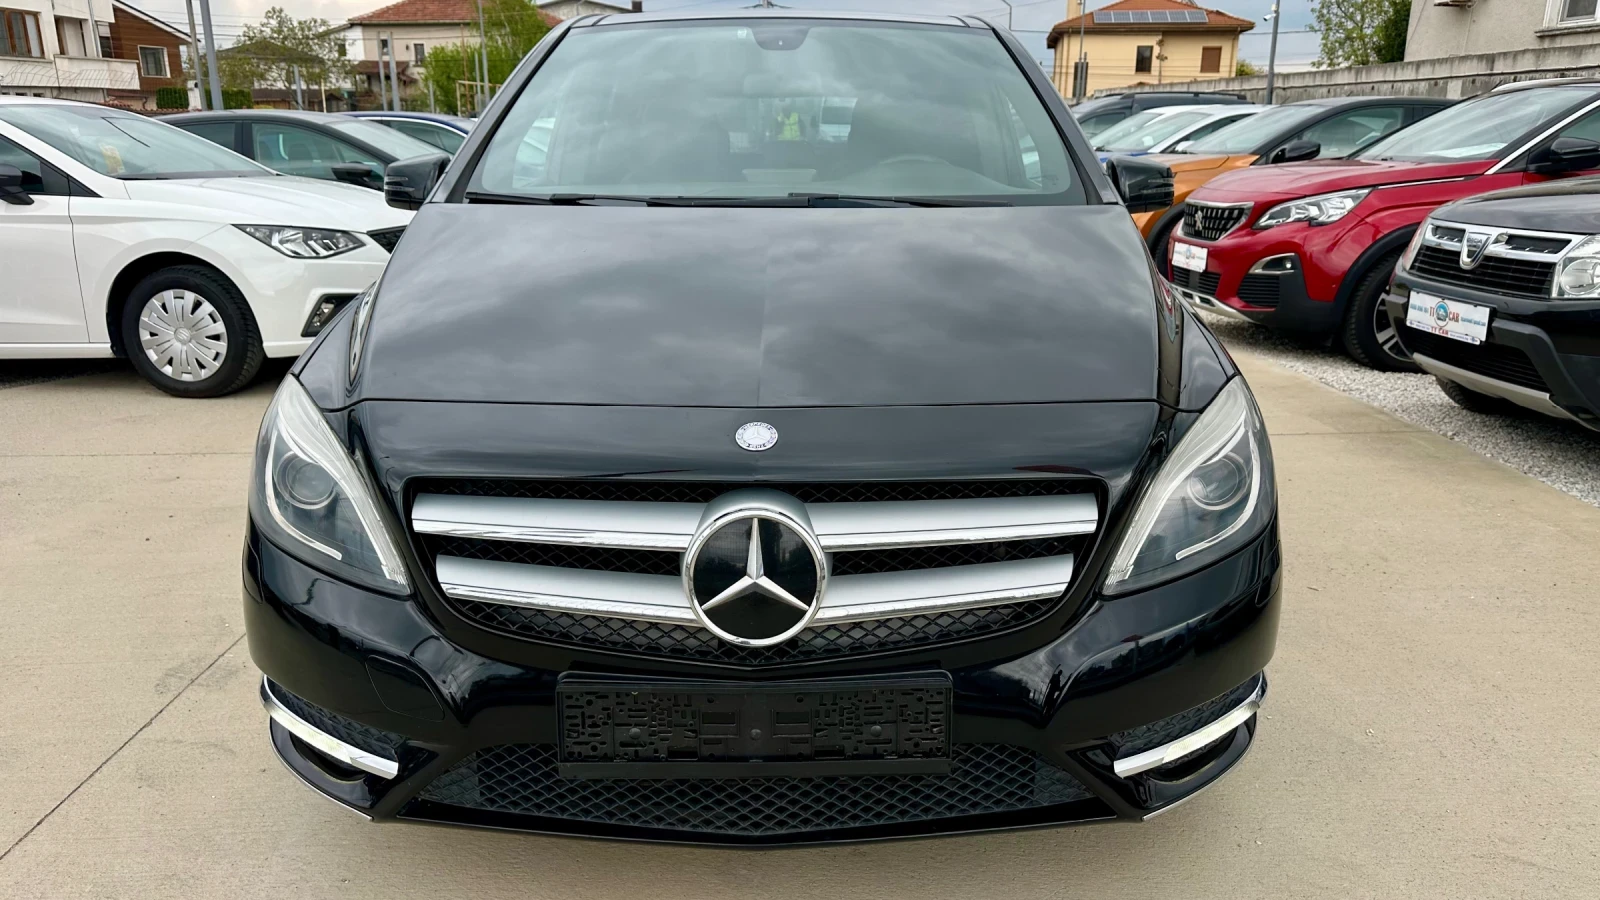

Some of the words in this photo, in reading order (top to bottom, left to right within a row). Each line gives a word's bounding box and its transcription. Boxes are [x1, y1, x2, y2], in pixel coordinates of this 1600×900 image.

[1429, 306, 1435, 317] TT
[1448, 312, 1460, 323] CAR
[1438, 328, 1449, 336] CAR
